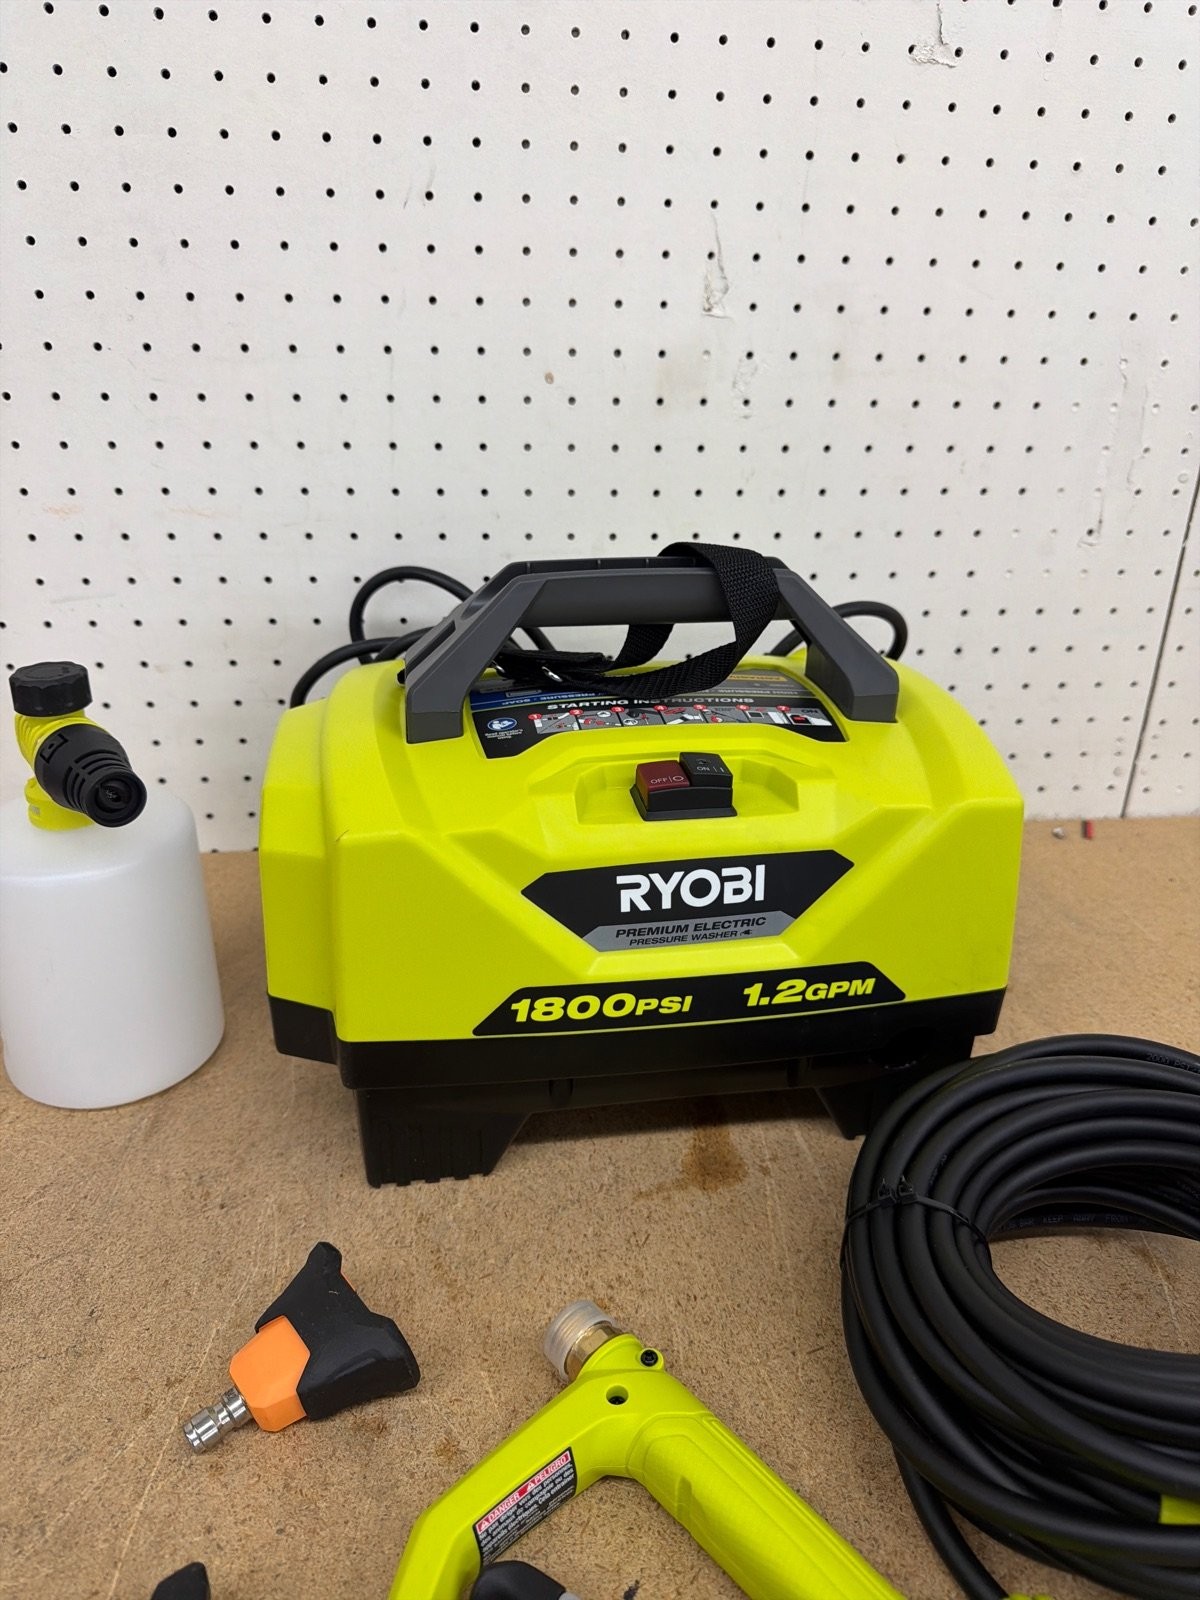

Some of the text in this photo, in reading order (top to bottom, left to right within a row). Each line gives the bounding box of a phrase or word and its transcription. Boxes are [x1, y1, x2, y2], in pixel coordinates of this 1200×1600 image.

[547, 697, 755, 710] STARTING INSTRUCTIONS
[650, 777, 668, 785] OFF
[615, 864, 766, 913] RYOBI
[615, 916, 767, 939] PREMIUM ELECTRIC
[629, 930, 738, 947] PRESSURE WASHER
[743, 978, 876, 1007] 1.2GPM
[510, 993, 693, 1022] 1800PSI
[487, 1491, 520, 1522] DANGER
[534, 1455, 566, 1484] PELIGRO
